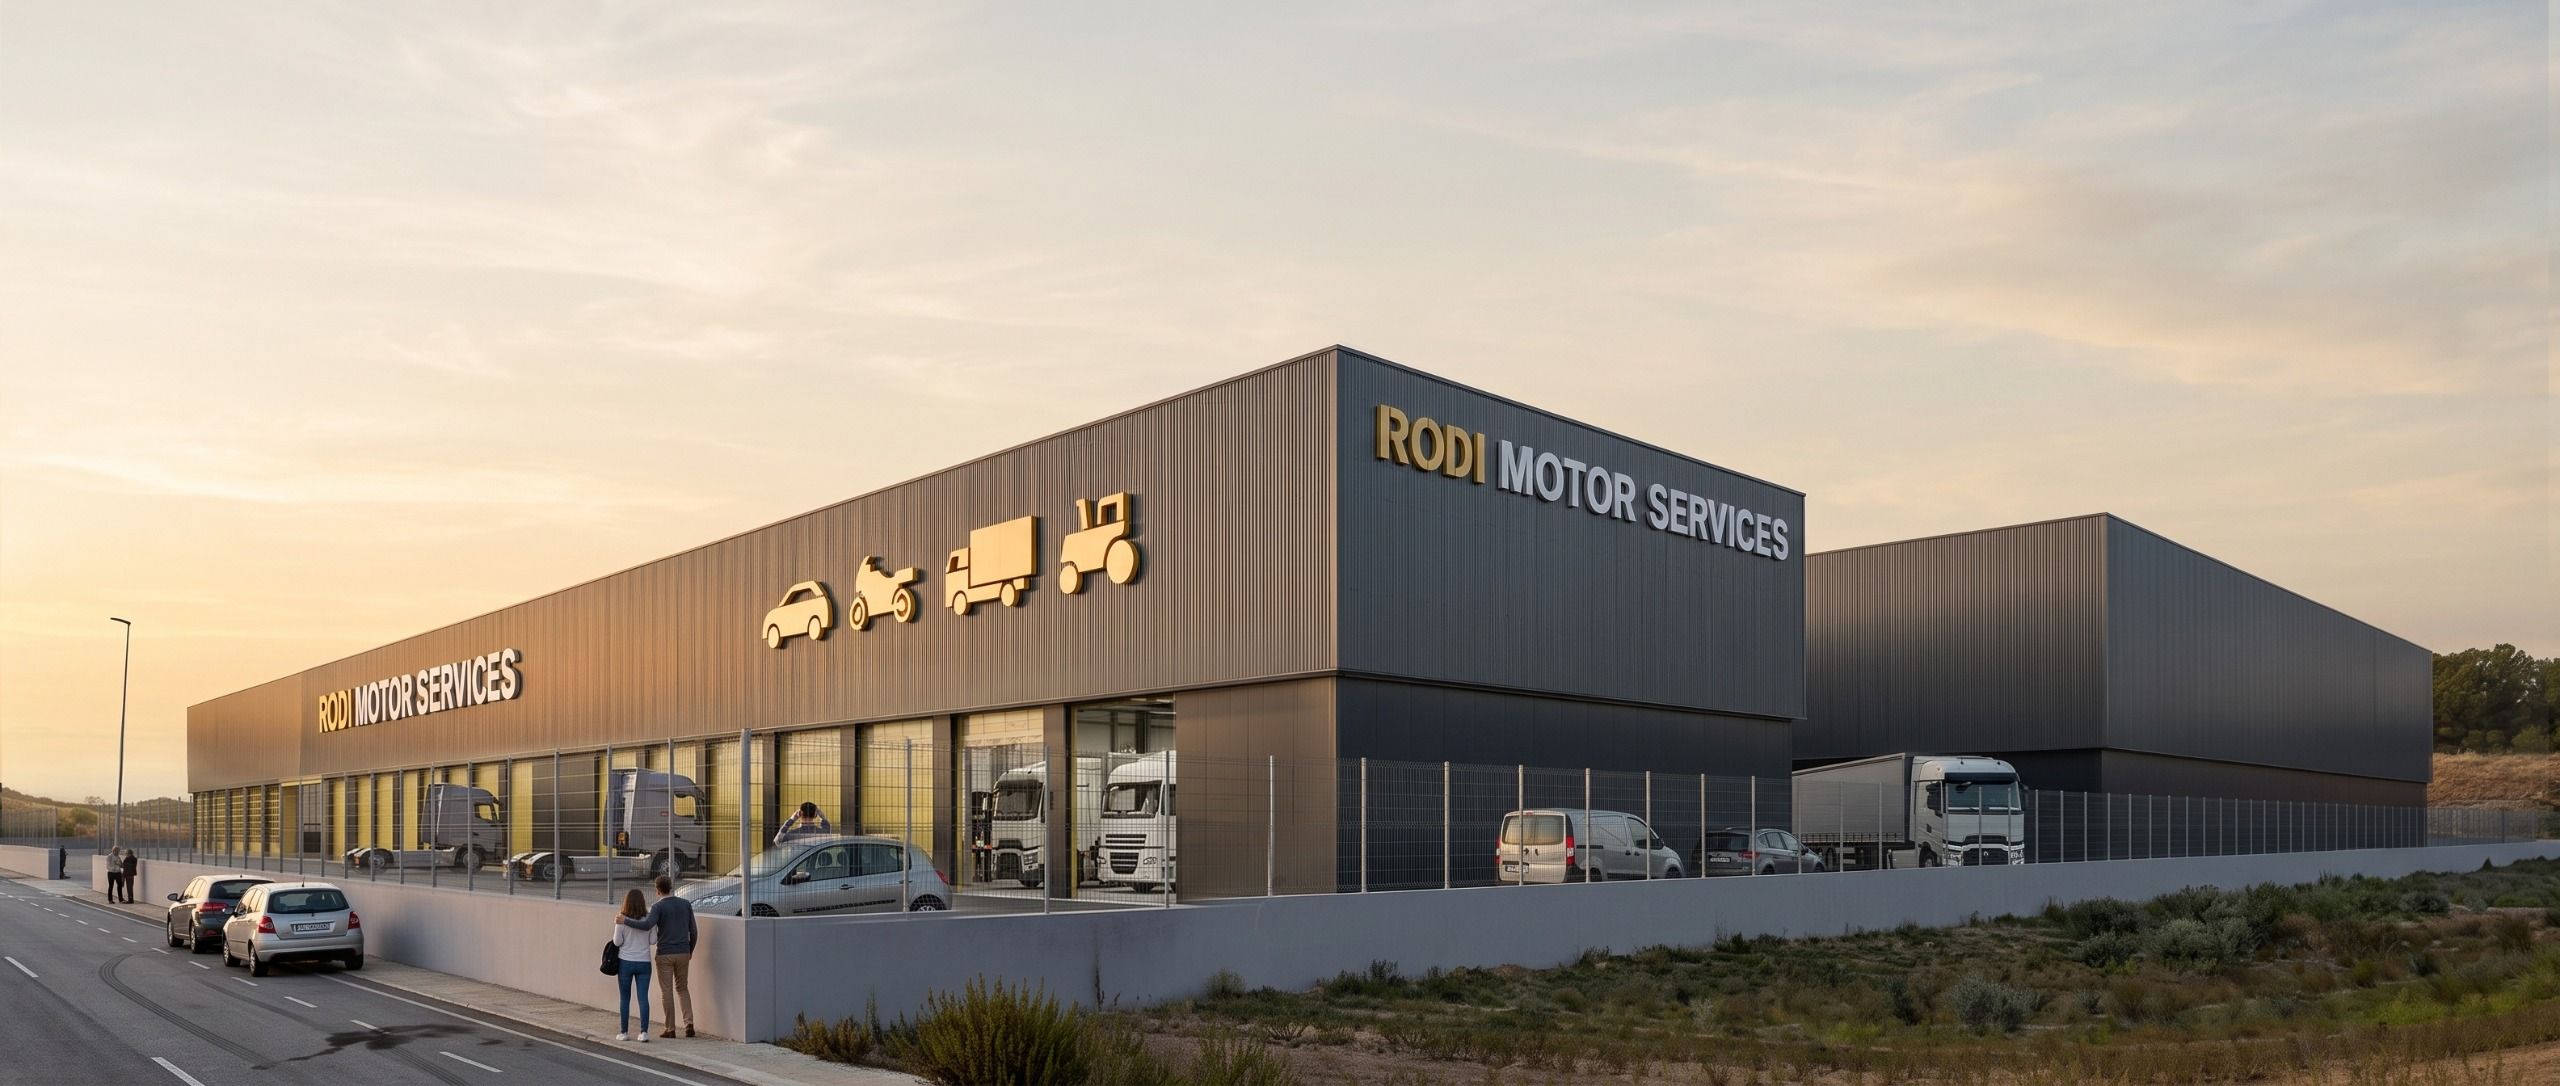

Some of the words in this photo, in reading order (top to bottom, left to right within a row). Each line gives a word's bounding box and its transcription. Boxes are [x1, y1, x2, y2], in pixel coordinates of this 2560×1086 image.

[1377, 404, 1485, 484] RODI
[1499, 439, 1636, 522] MOTOR
[1648, 483, 1789, 561] SERVICES
[319, 689, 352, 733] RODI
[355, 674, 413, 726] MOTOR
[416, 647, 519, 715] SERVICES
